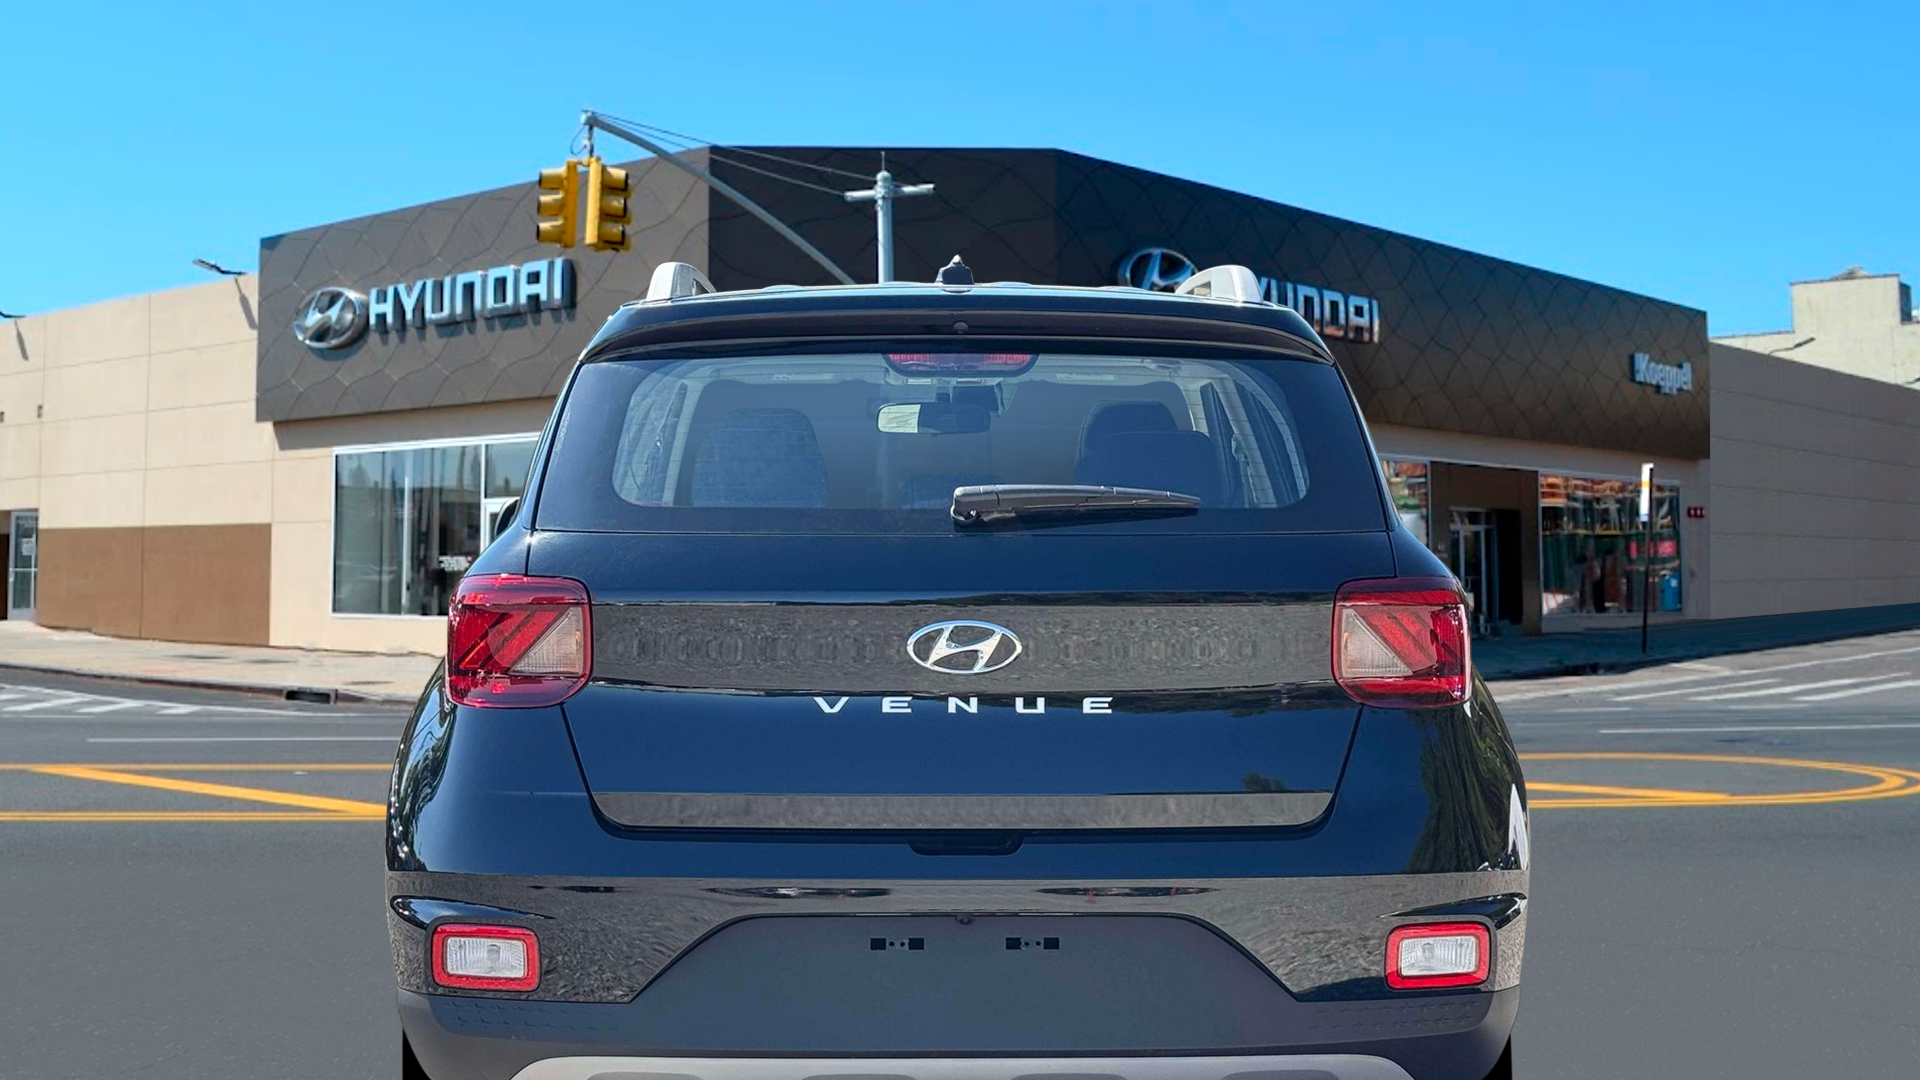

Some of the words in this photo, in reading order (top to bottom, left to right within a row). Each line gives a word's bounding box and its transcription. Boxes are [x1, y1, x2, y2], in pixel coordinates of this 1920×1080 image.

[369, 256, 575, 329] HYUNDAI
[1260, 276, 1379, 343] UNDAI
[1633, 352, 1692, 394] Koeppel
[813, 696, 1114, 714] VENUE
